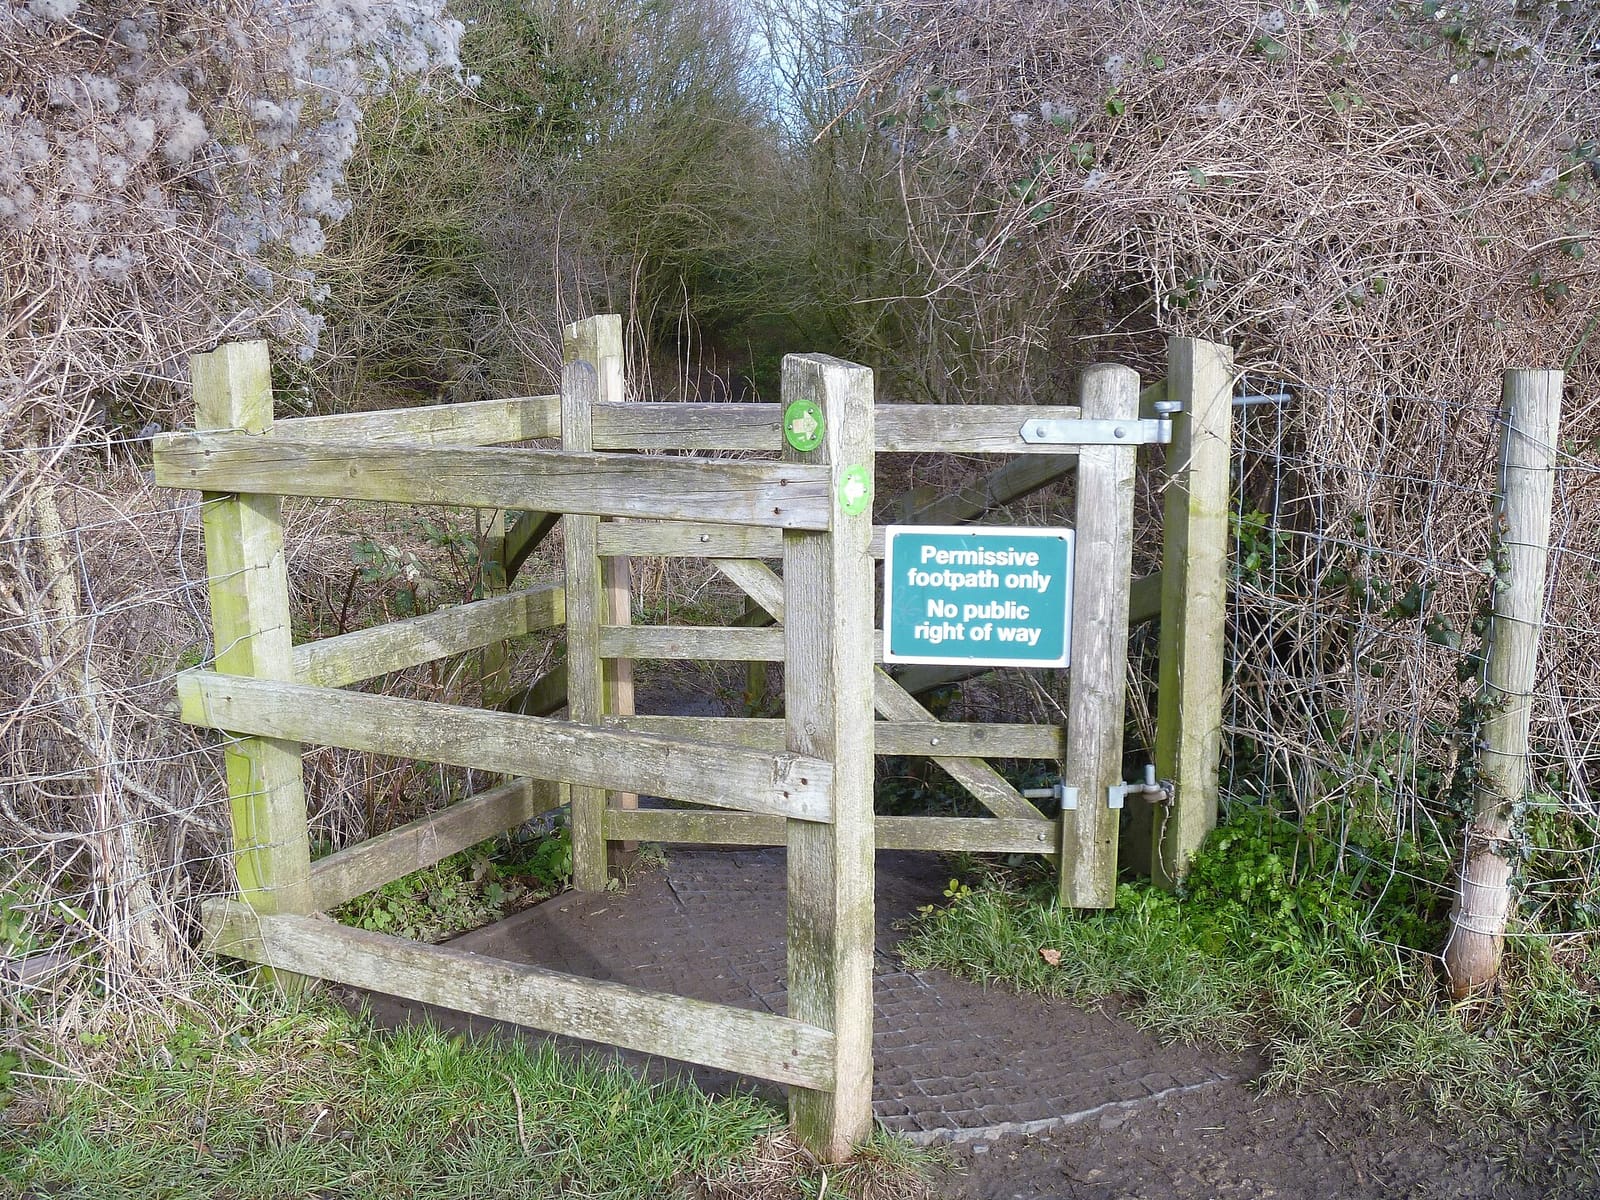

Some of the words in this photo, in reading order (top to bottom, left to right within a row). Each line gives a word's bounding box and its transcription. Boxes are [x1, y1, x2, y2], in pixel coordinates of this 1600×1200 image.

[921, 545, 1040, 566] Permissive
[907, 568, 999, 591] footpath
[1005, 570, 1051, 593] only
[927, 599, 958, 618] No
[963, 601, 1030, 622] public
[914, 622, 965, 644] right
[970, 623, 993, 641] of
[997, 627, 1042, 646] way
